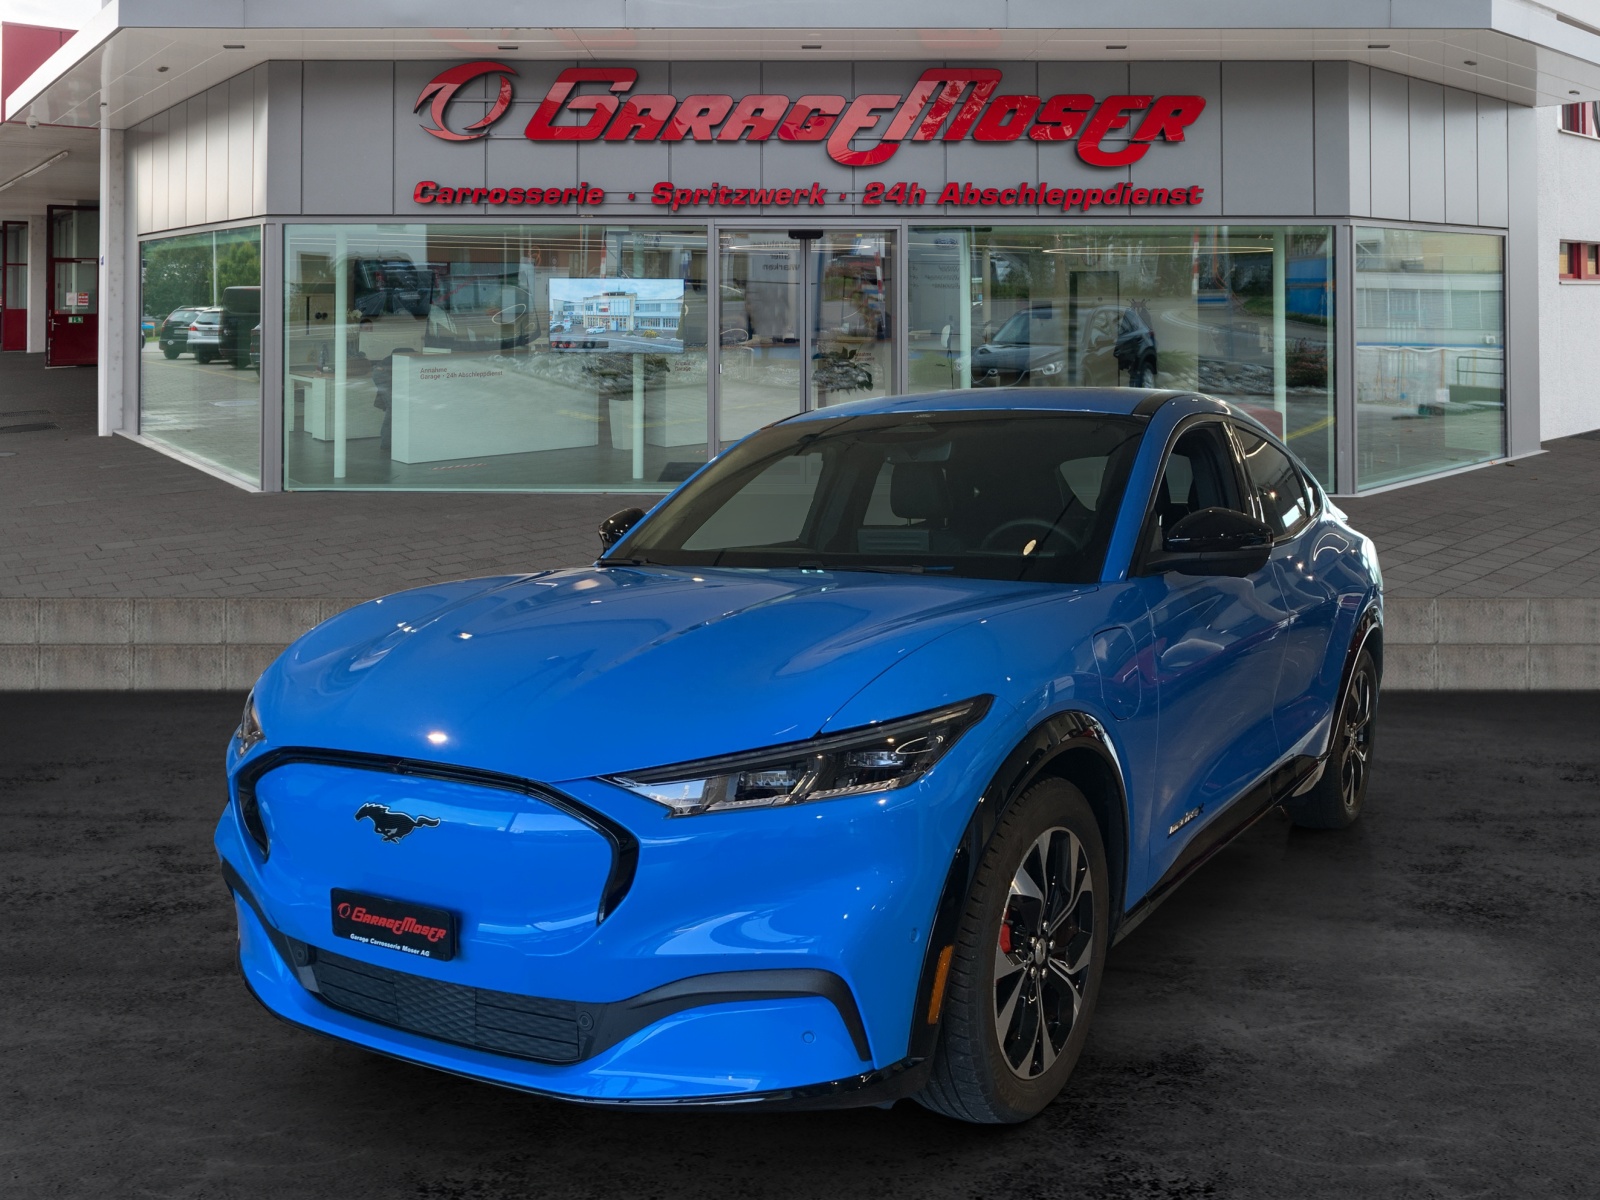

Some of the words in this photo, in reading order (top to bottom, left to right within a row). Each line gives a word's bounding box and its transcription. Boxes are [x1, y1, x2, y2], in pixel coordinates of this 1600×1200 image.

[413, 180, 605, 206] Carrosserie
[651, 181, 827, 211] Spritzwerk
[862, 182, 927, 206] 24h
[937, 182, 1206, 212] Abschleppdienst
[458, 370, 503, 378] Abschleppdienst
[350, 933, 369, 944] Garage
[370, 938, 401, 951] Carrosserie
[401, 945, 420, 955] Moser
